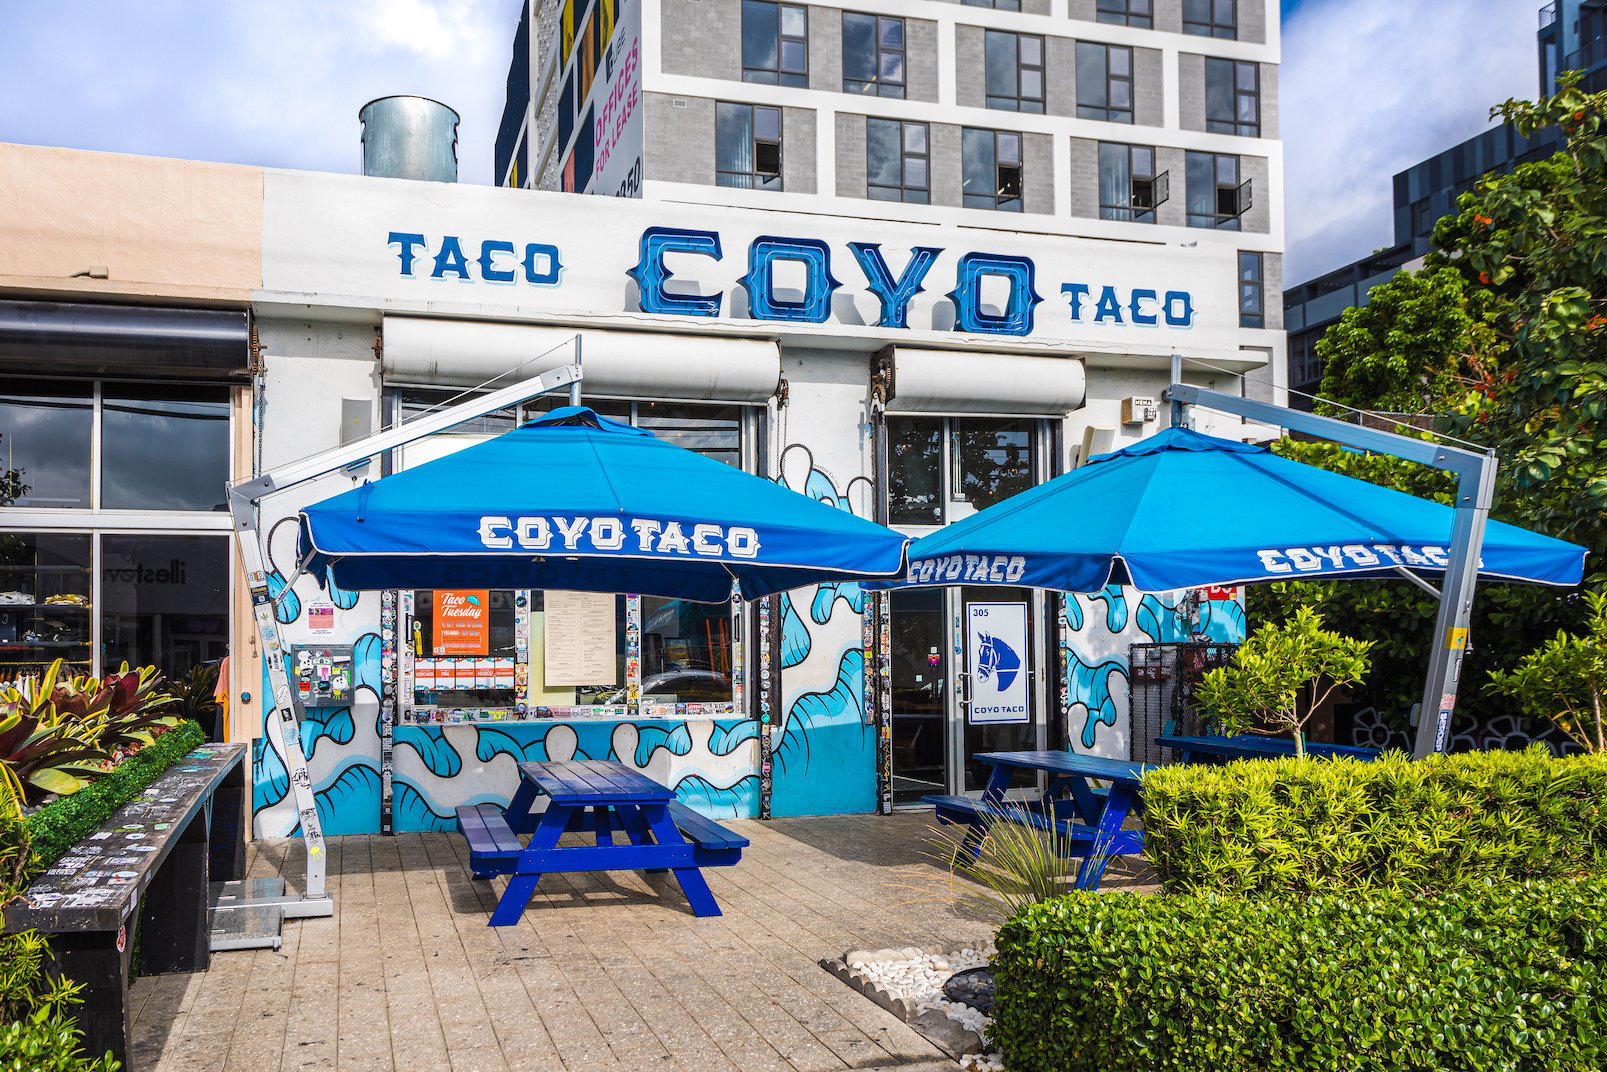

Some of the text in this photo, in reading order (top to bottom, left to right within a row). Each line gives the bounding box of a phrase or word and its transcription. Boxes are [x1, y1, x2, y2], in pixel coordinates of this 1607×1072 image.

[595, 35, 638, 148] OFFICES
[596, 142, 610, 181] FOR
[611, 81, 638, 148] LEASE
[387, 226, 1198, 336] TACO COYO TACO
[1256, 544, 1485, 573] COYO TAC
[440, 592, 466, 605] Taco
[440, 604, 483, 620] Tuesday
[973, 608, 989, 617] 305
